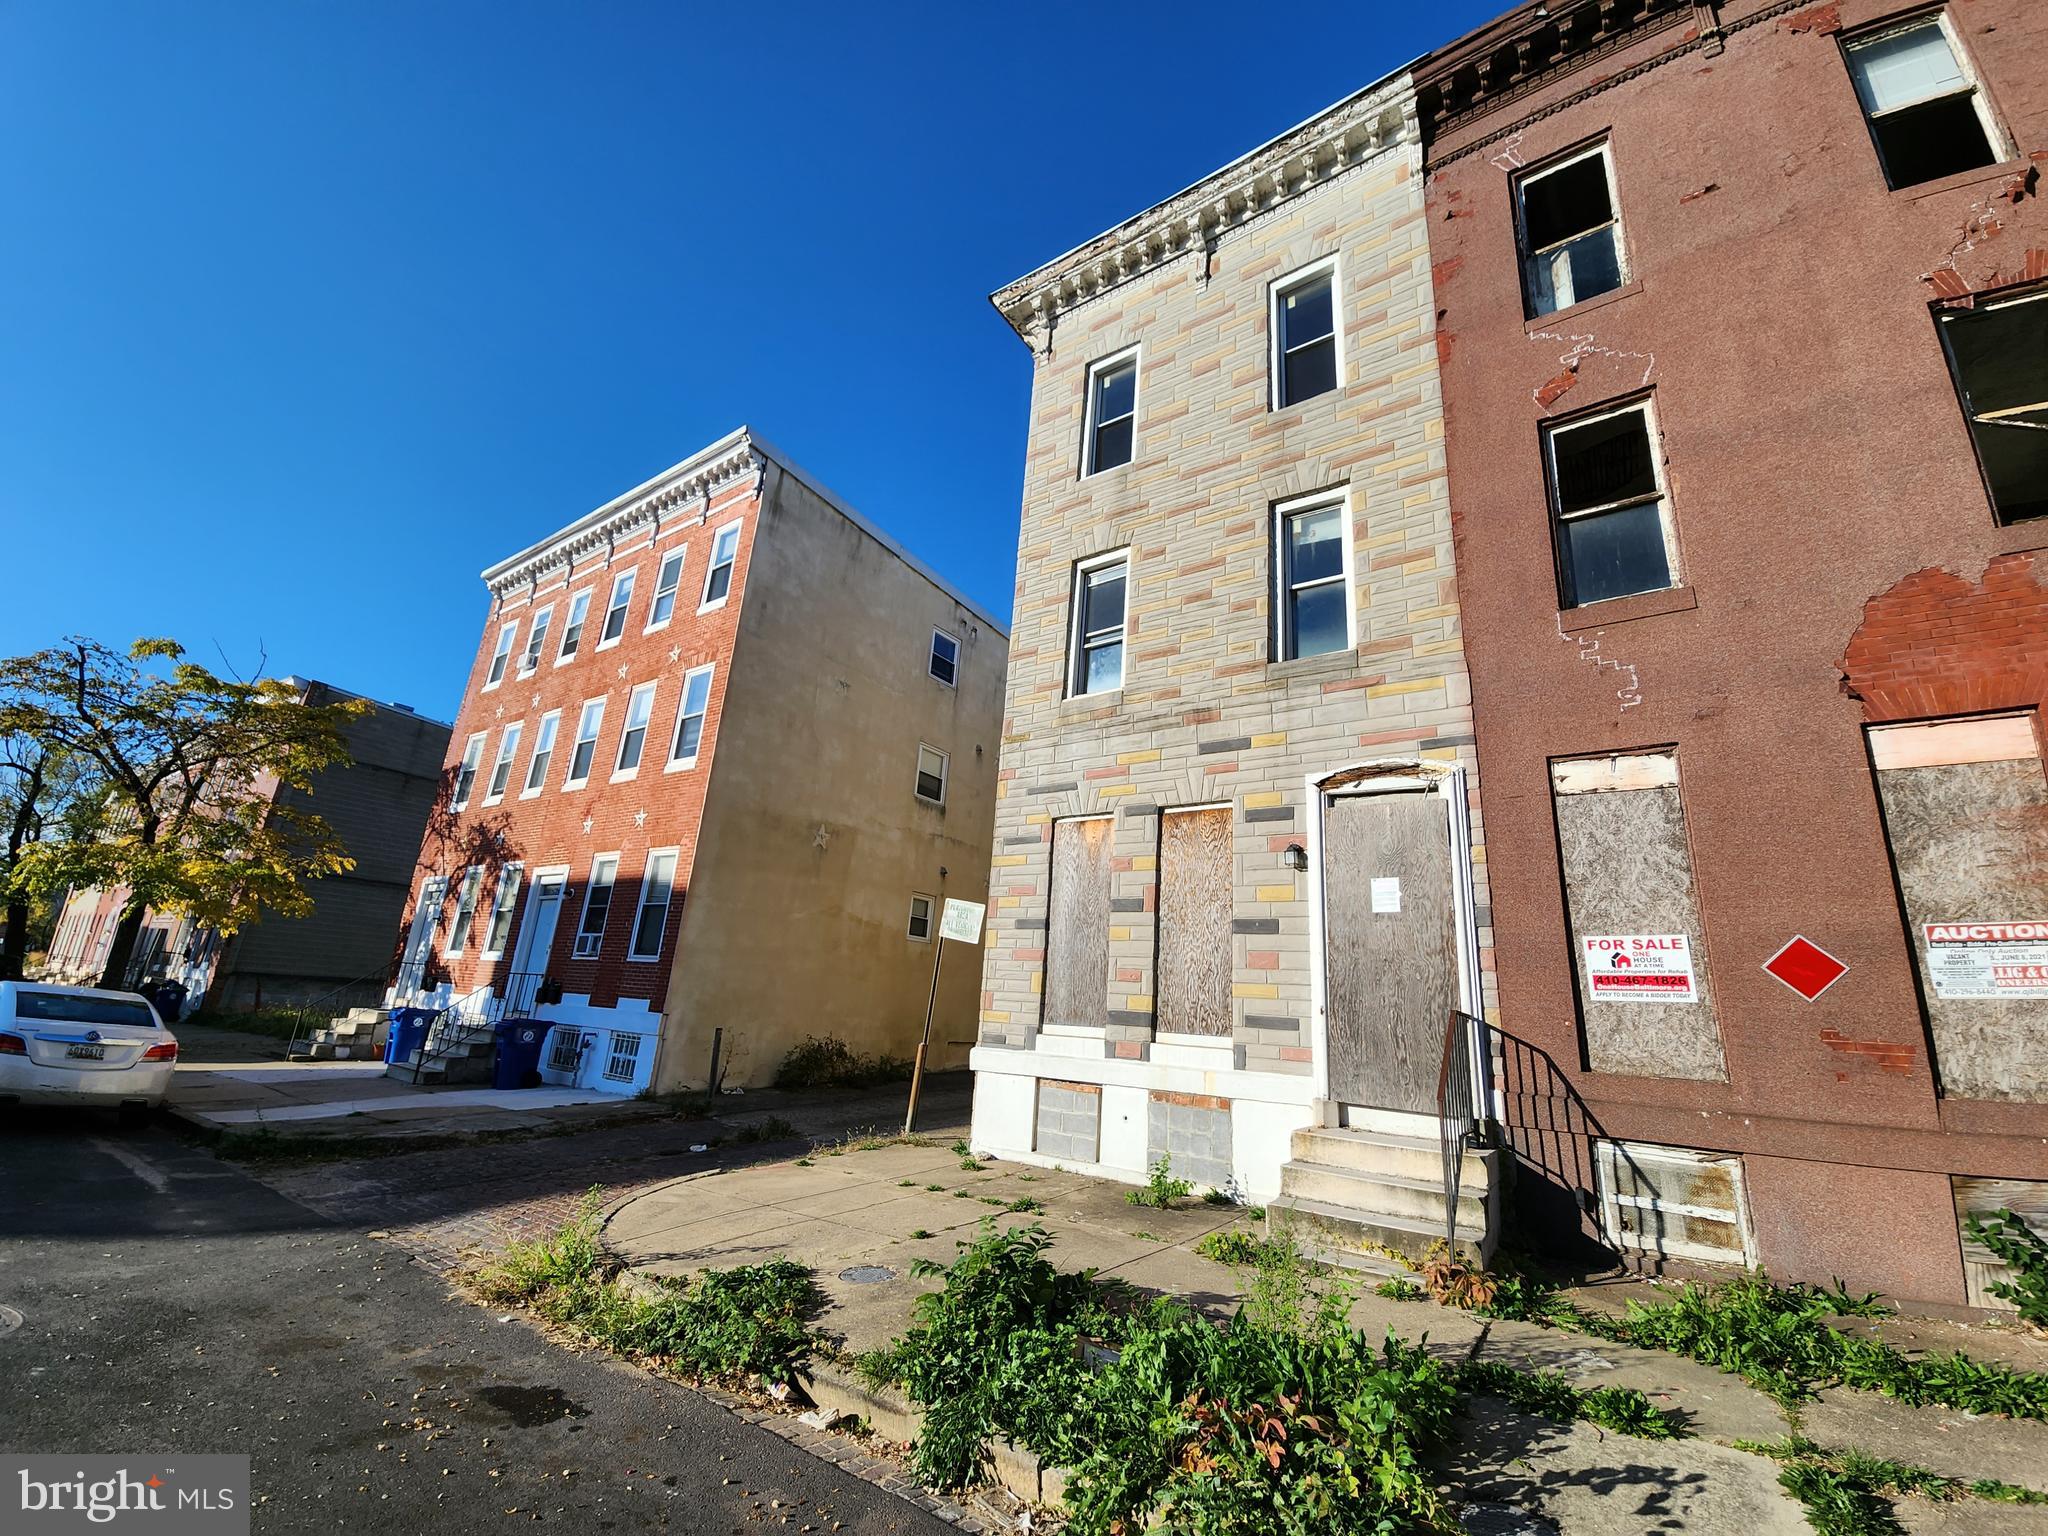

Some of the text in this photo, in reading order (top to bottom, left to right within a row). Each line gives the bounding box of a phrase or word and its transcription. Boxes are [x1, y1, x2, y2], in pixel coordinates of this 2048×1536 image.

[1931, 924, 2048, 940] AUCTION
[1587, 938, 1684, 950] FOR SALE
[2026, 966, 2039, 977] &
[1596, 976, 1687, 985] 410-467-1826
